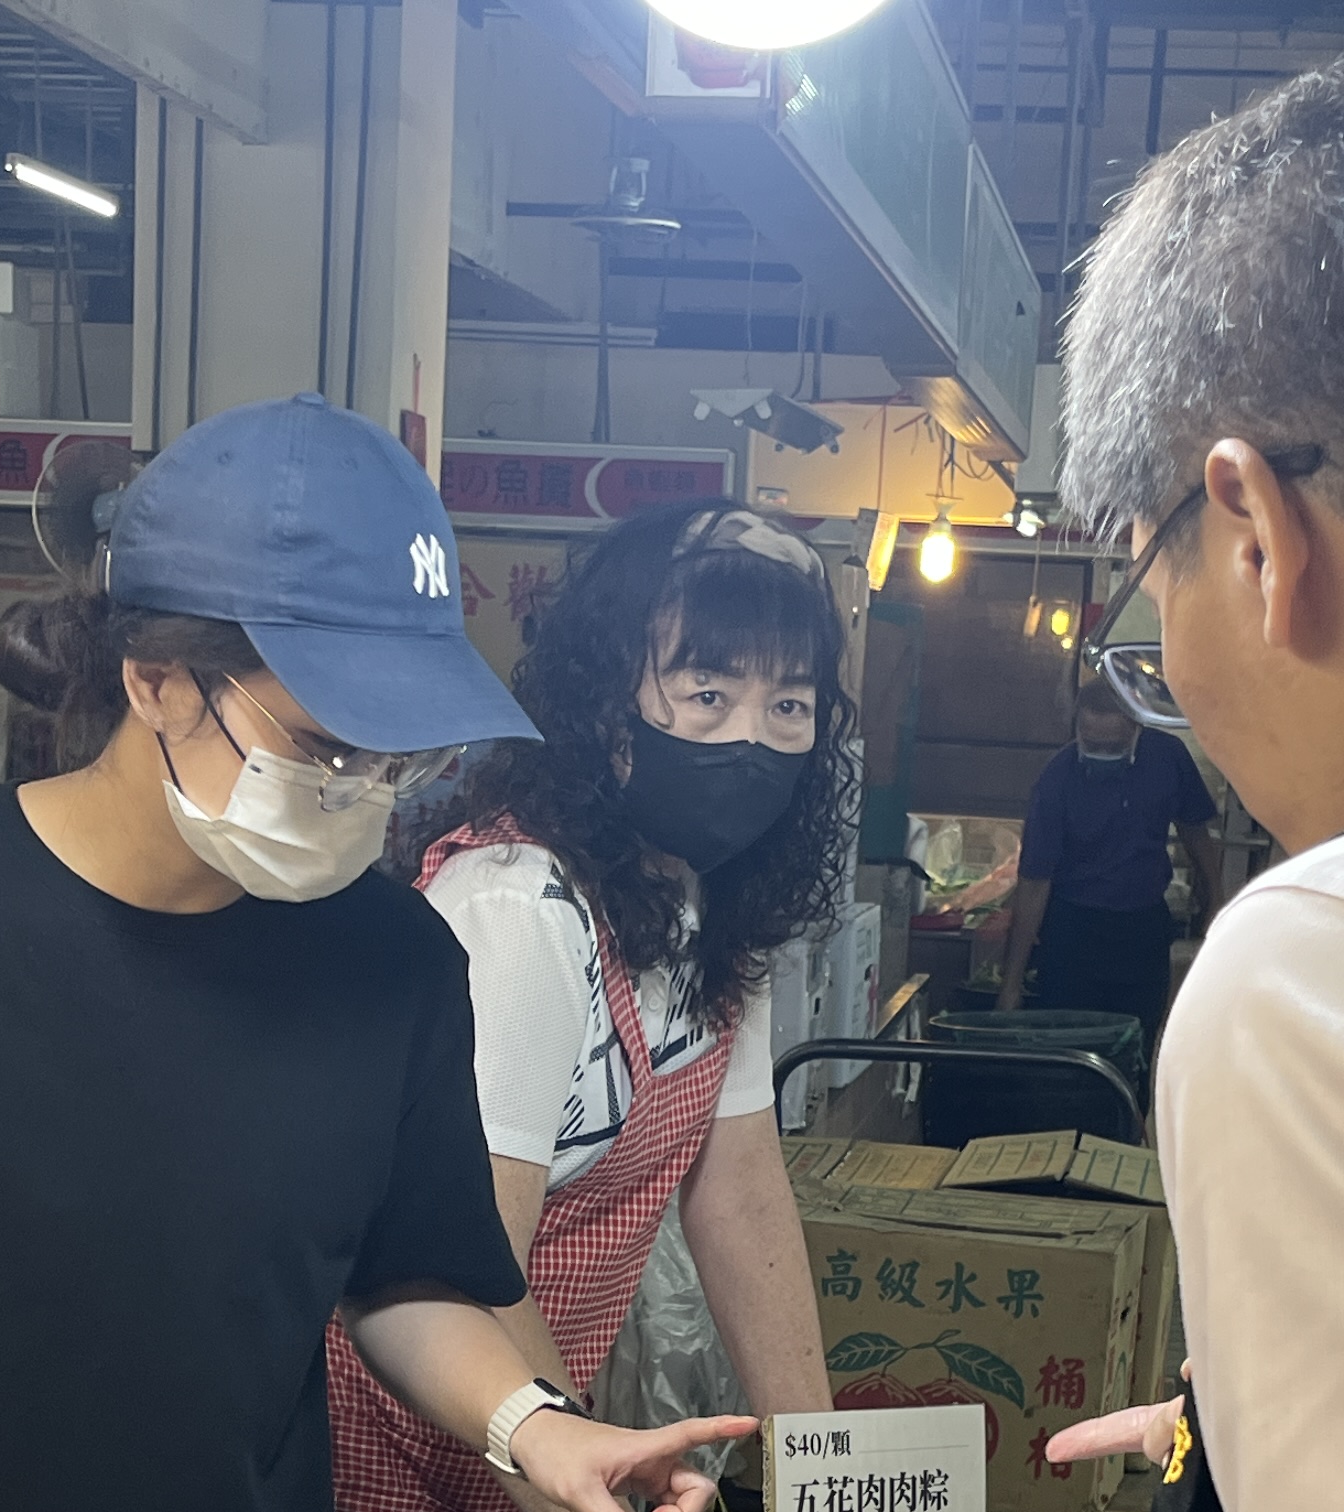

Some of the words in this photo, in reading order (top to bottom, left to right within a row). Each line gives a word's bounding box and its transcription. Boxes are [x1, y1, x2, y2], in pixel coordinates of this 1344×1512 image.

[409, 533, 450, 599] NY
[820, 1249, 1045, 1319] 高級水果
[784, 1429, 851, 1460] $40/顆
